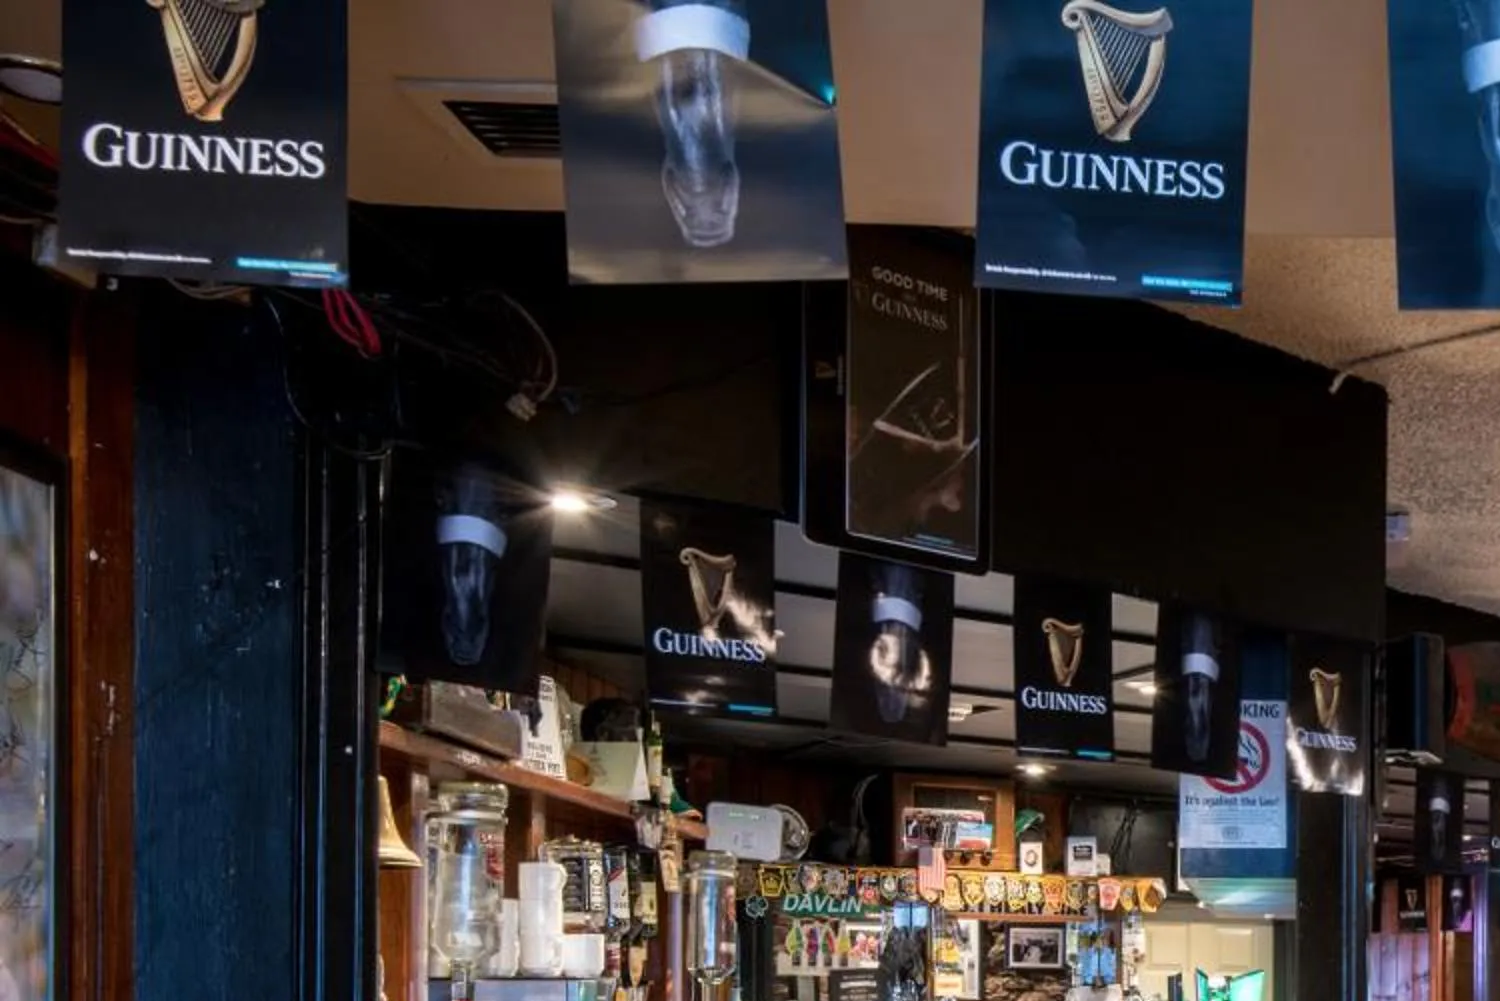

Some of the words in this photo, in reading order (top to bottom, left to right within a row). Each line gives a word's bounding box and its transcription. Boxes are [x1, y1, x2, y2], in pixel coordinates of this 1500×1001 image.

[82, 123, 325, 179] GUINNESS
[1000, 141, 1225, 199] GUINNESS
[872, 266, 913, 289] GOOD
[916, 280, 948, 302] TIME
[872, 293, 948, 331] GUINNESS
[653, 627, 766, 663] GUINNESS
[1022, 685, 1107, 715] GUINNESS
[1241, 703, 1280, 718] KING
[1298, 727, 1357, 752] GUINNESS
